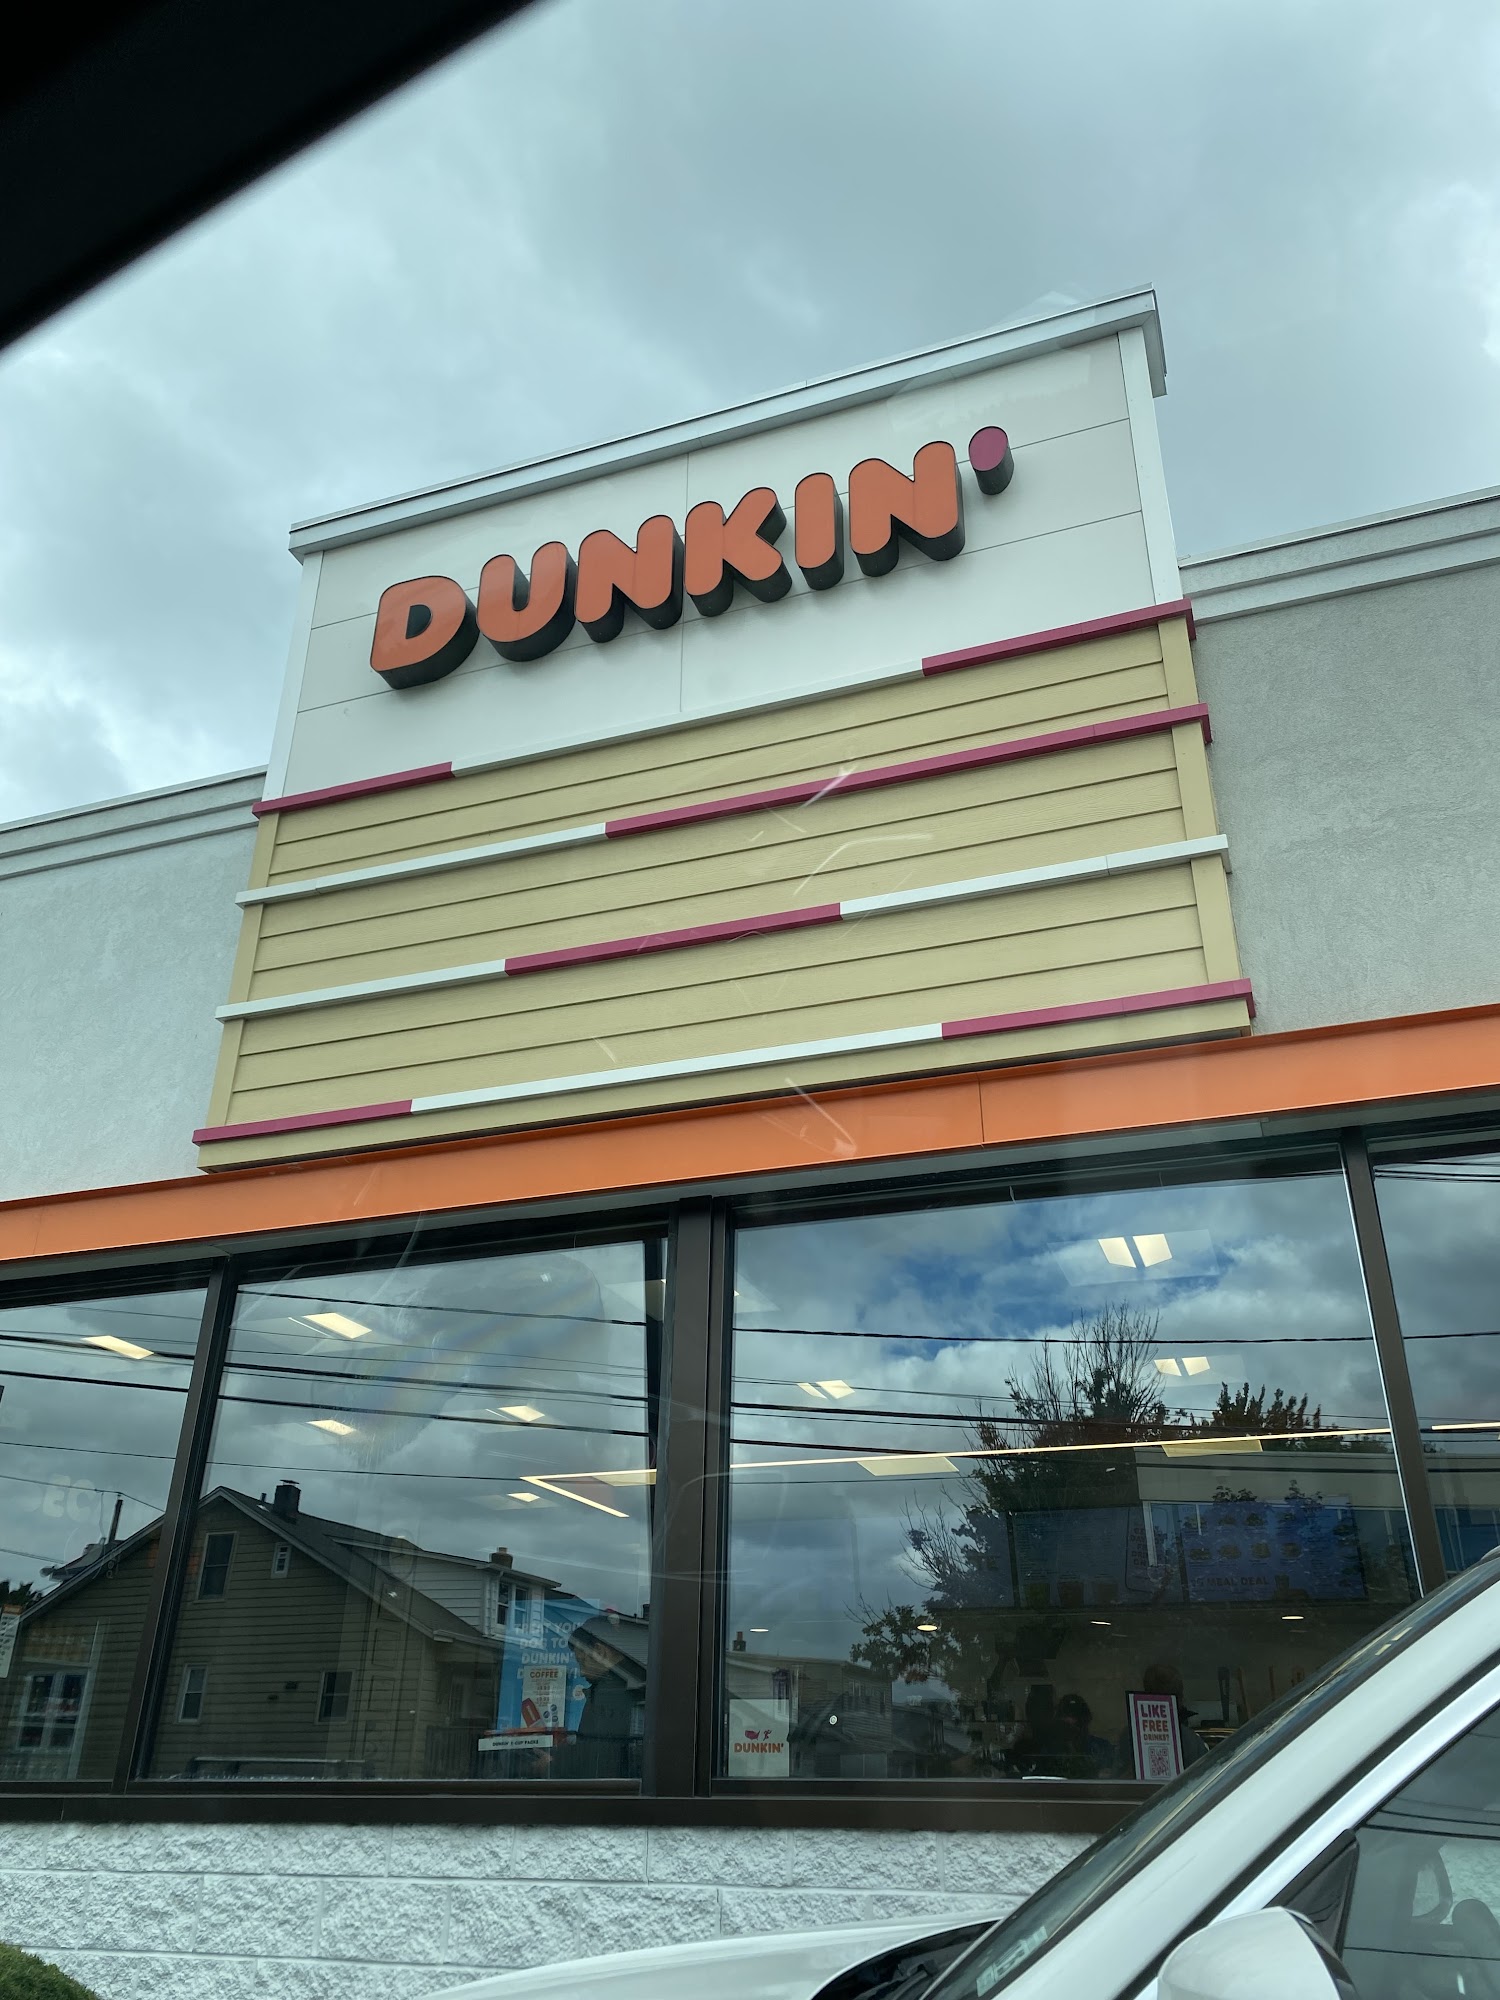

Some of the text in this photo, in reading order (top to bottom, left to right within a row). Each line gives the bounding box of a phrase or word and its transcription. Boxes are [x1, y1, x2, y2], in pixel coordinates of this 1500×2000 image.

[370, 426, 1013, 690] DUNKIN'
[521, 1652, 573, 1664] DUNKIN'
[530, 1671, 559, 1679] COFFEE
[1141, 1704, 1167, 1718] LIKE
[1142, 1720, 1168, 1732] FREE
[734, 1743, 784, 1753] DUNKIN'
